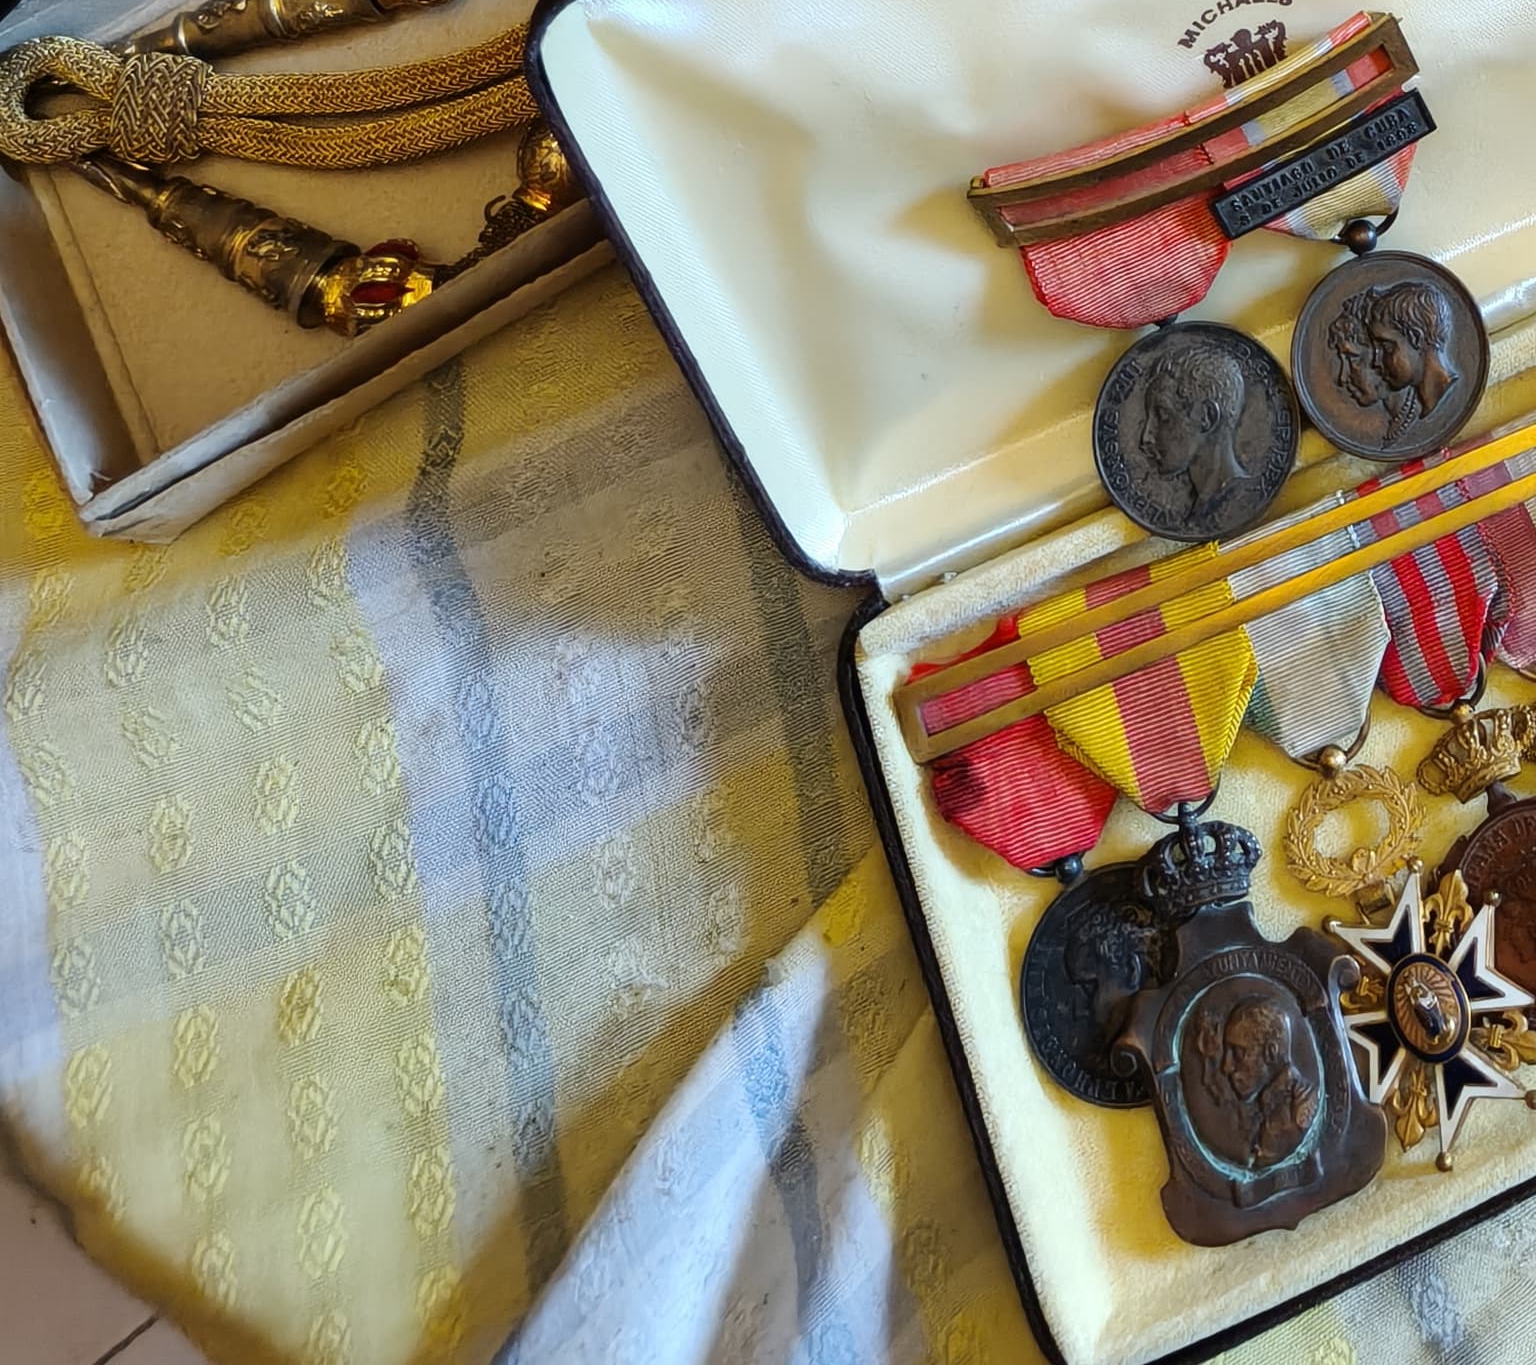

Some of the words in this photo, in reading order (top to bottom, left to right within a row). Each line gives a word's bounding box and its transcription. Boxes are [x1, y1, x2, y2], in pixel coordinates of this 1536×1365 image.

[1231, 156, 1315, 214] SANTIAGO
[1325, 139, 1351, 161] DE
[1362, 107, 1412, 141] CUBA
